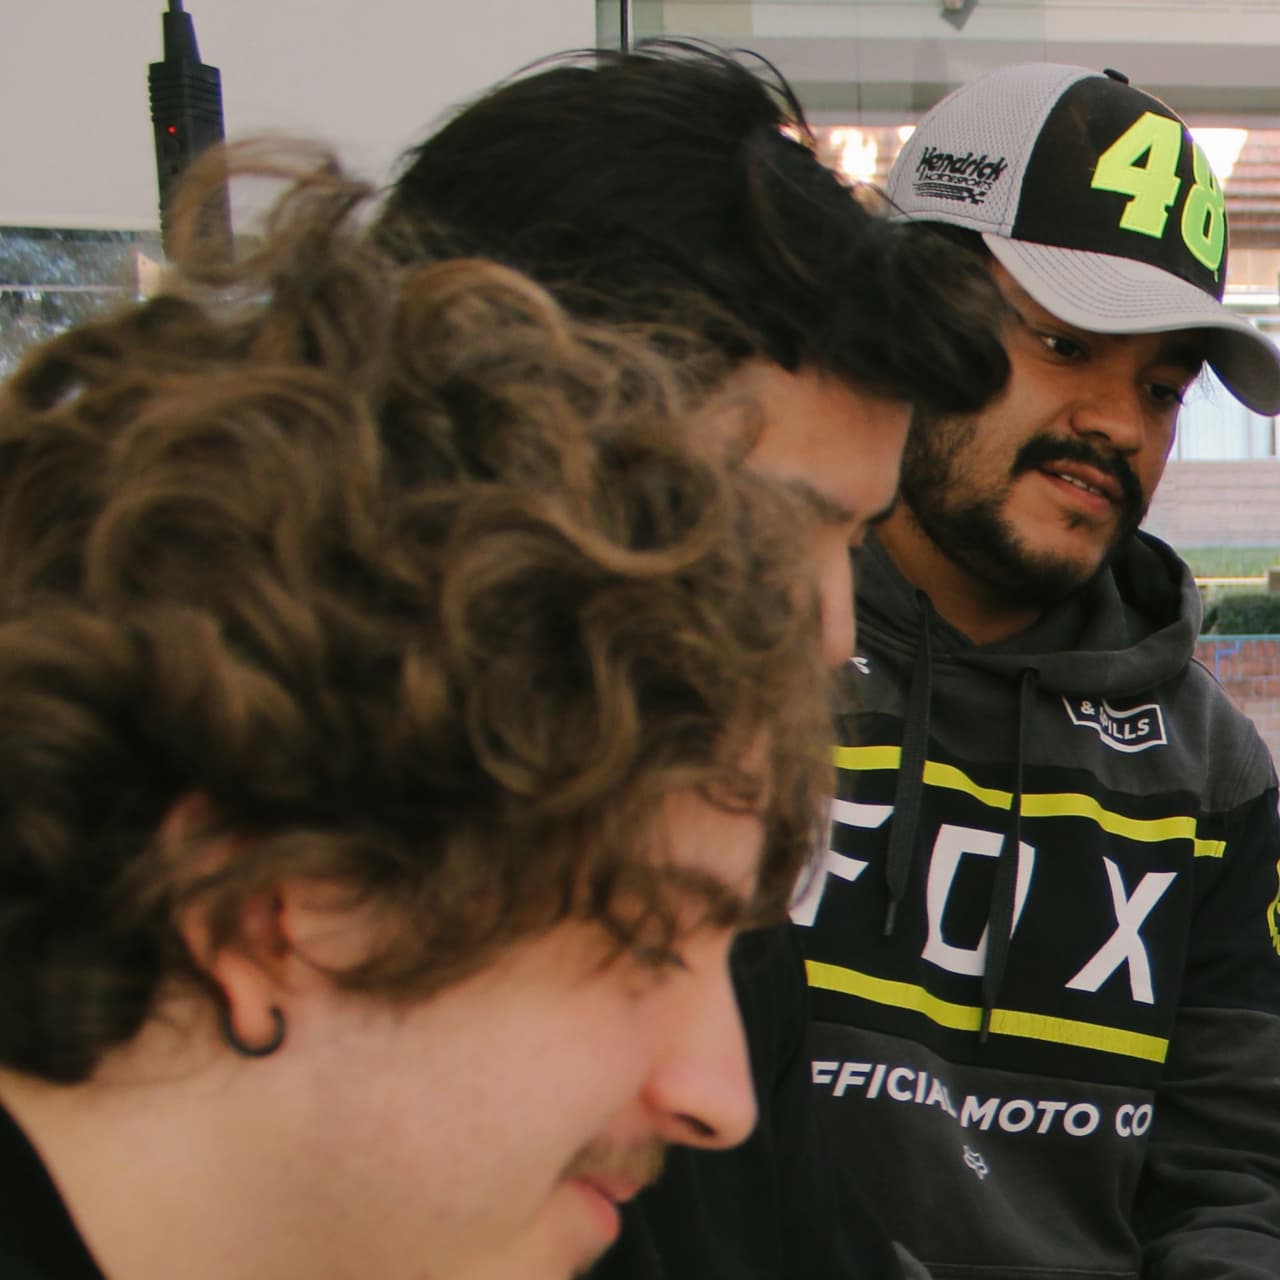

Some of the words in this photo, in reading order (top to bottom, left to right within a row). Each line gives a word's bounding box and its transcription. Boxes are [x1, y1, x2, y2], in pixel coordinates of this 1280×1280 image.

[916, 147, 1008, 181] Hendrick
[1091, 111, 1225, 271] 48
[789, 798, 1178, 1005] FOX
[810, 1060, 958, 1118] FFICIAL
[960, 1095, 1100, 1137] MOTO
